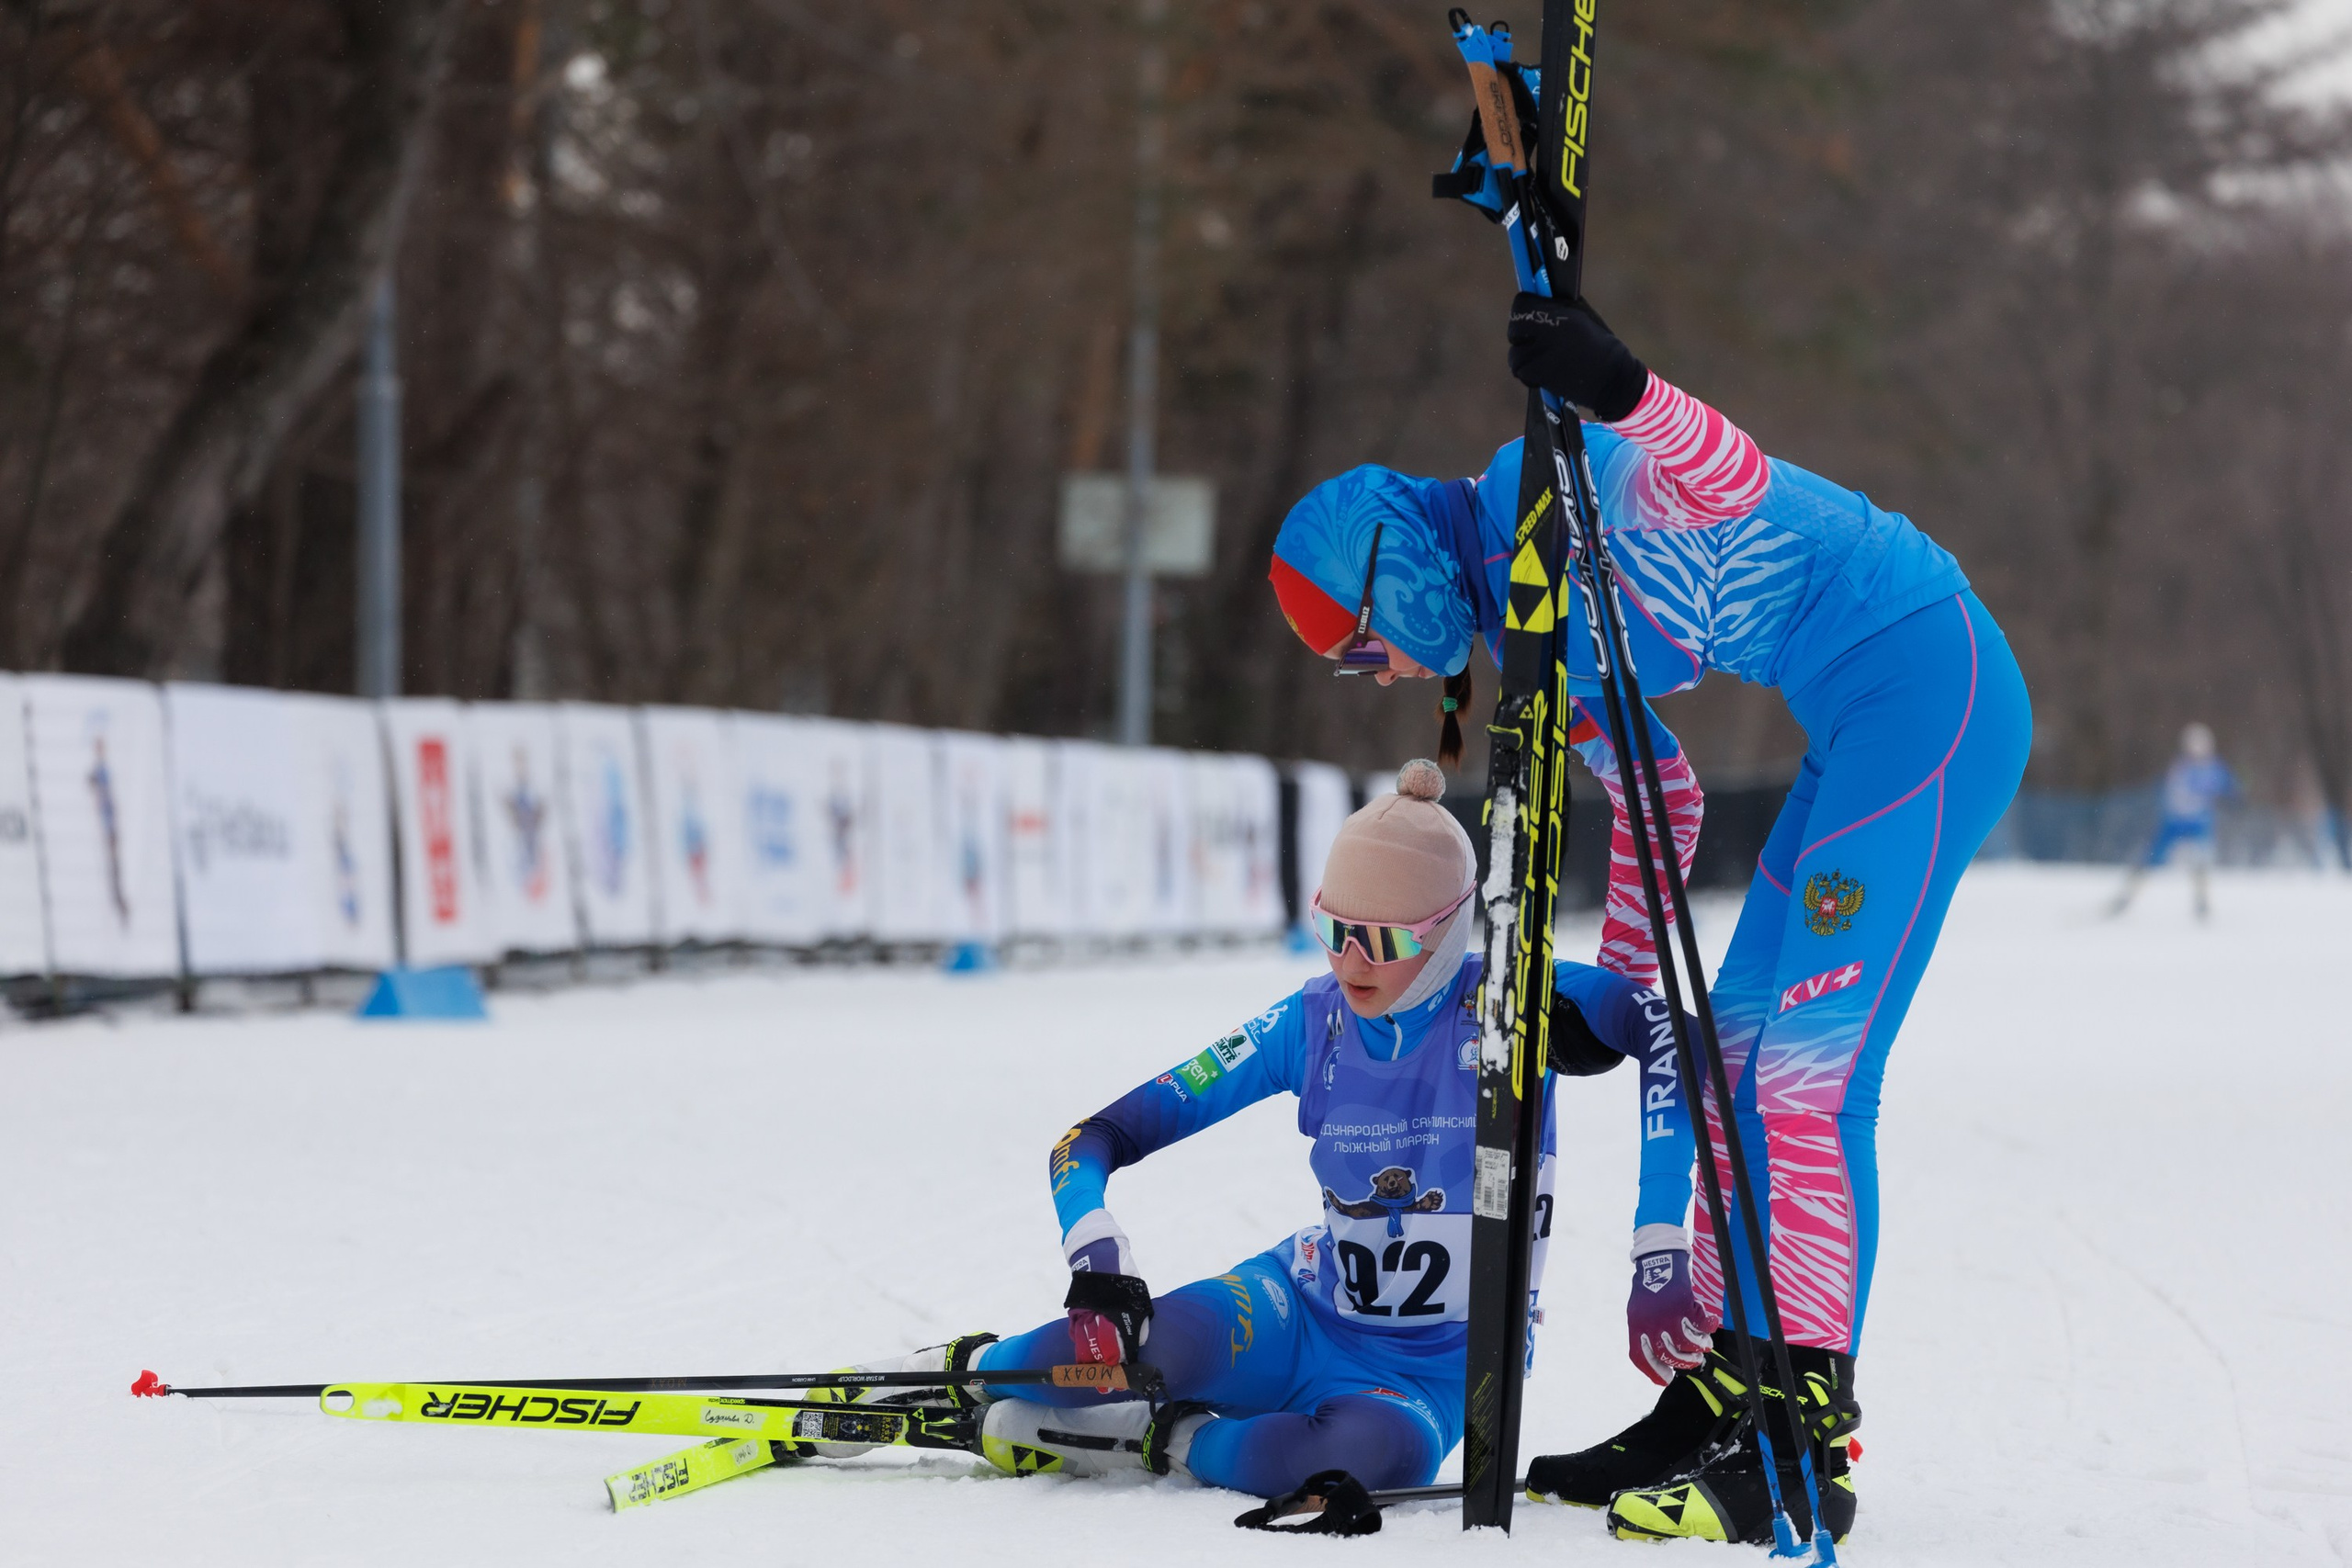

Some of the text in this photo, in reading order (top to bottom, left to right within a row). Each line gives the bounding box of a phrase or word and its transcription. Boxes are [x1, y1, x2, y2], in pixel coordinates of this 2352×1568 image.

[1511, 689, 1548, 1100] FISCHER
[1632, 988, 1676, 1141] FRANCE
[1159, 1076, 1188, 1102] LAPUA
[1334, 1138, 1391, 1154] ЛЫЖНЫЙ
[1643, 1256, 1670, 1268] HESTRA
[1337, 1239, 1451, 1317] 92
[1063, 1366, 1114, 1382] MOAX
[421, 1391, 642, 1426] FISCHER
